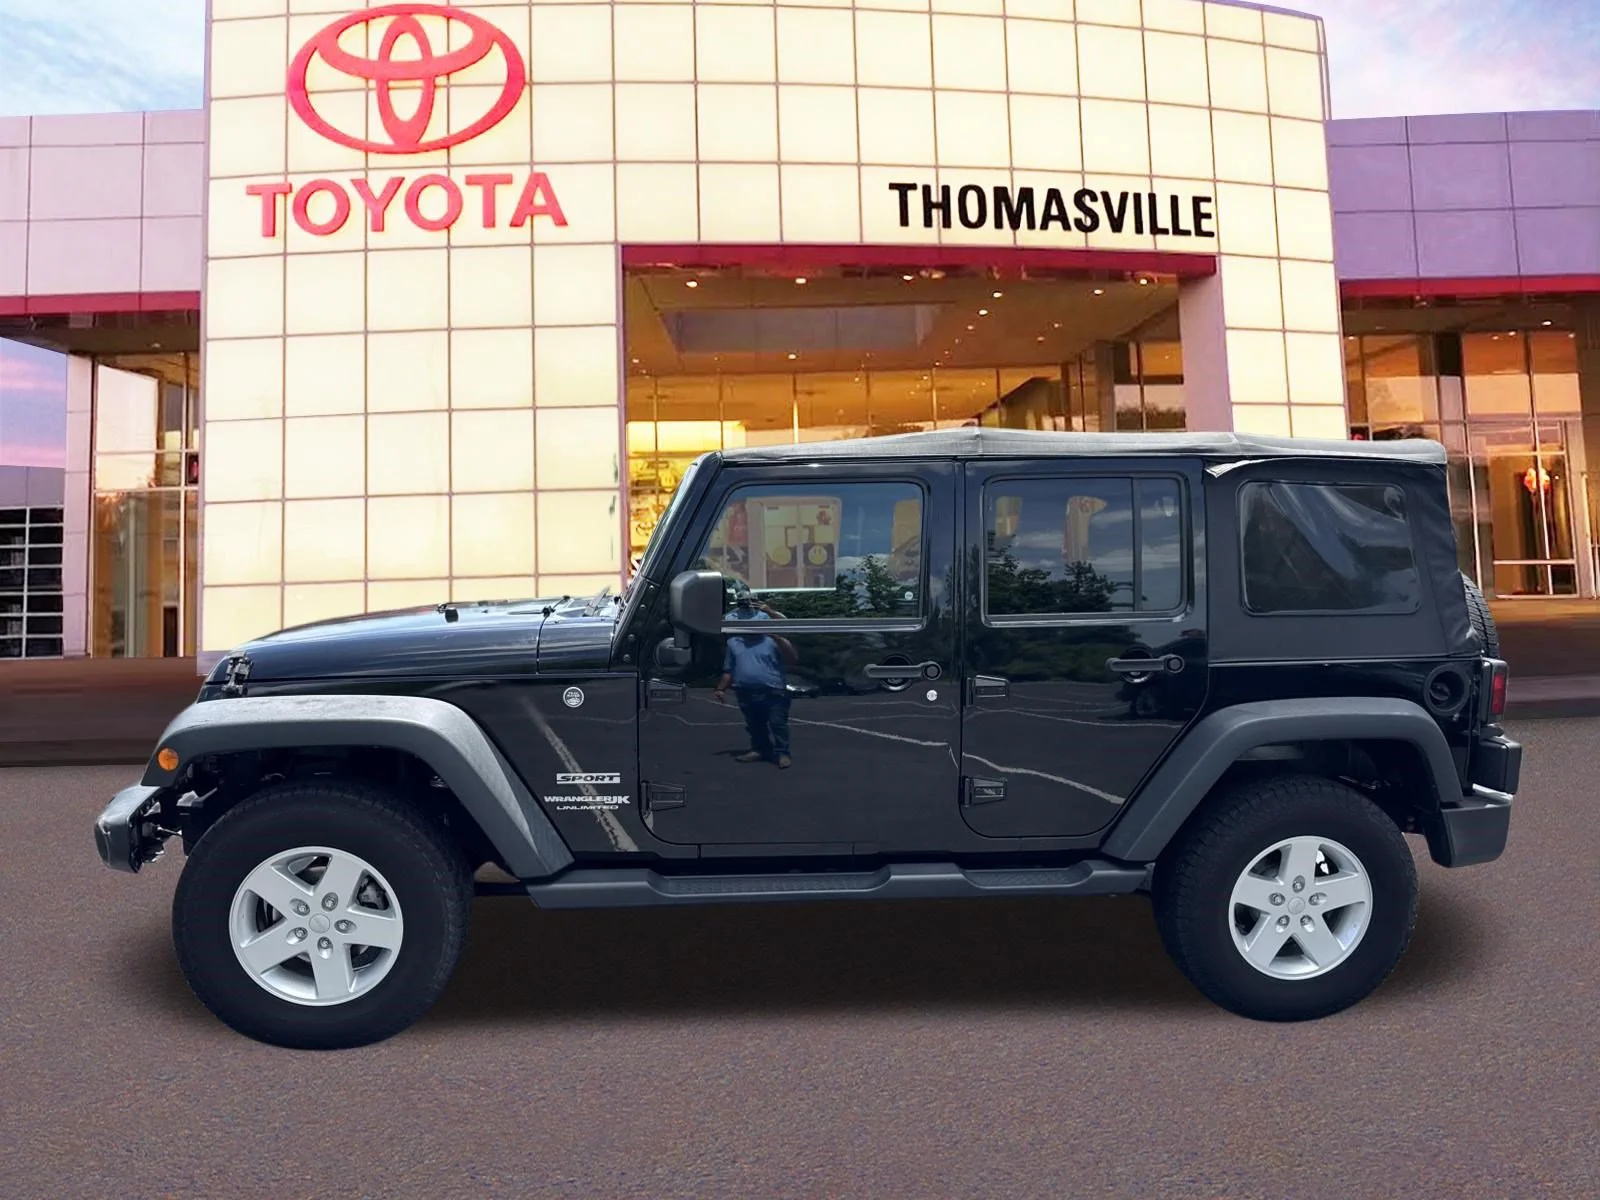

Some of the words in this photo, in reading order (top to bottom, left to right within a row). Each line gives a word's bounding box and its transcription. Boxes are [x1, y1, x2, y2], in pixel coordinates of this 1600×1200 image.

[246, 172, 568, 238] TOYOTA
[888, 182, 1217, 238] THOMASVILLE
[558, 774, 618, 784] SPORT
